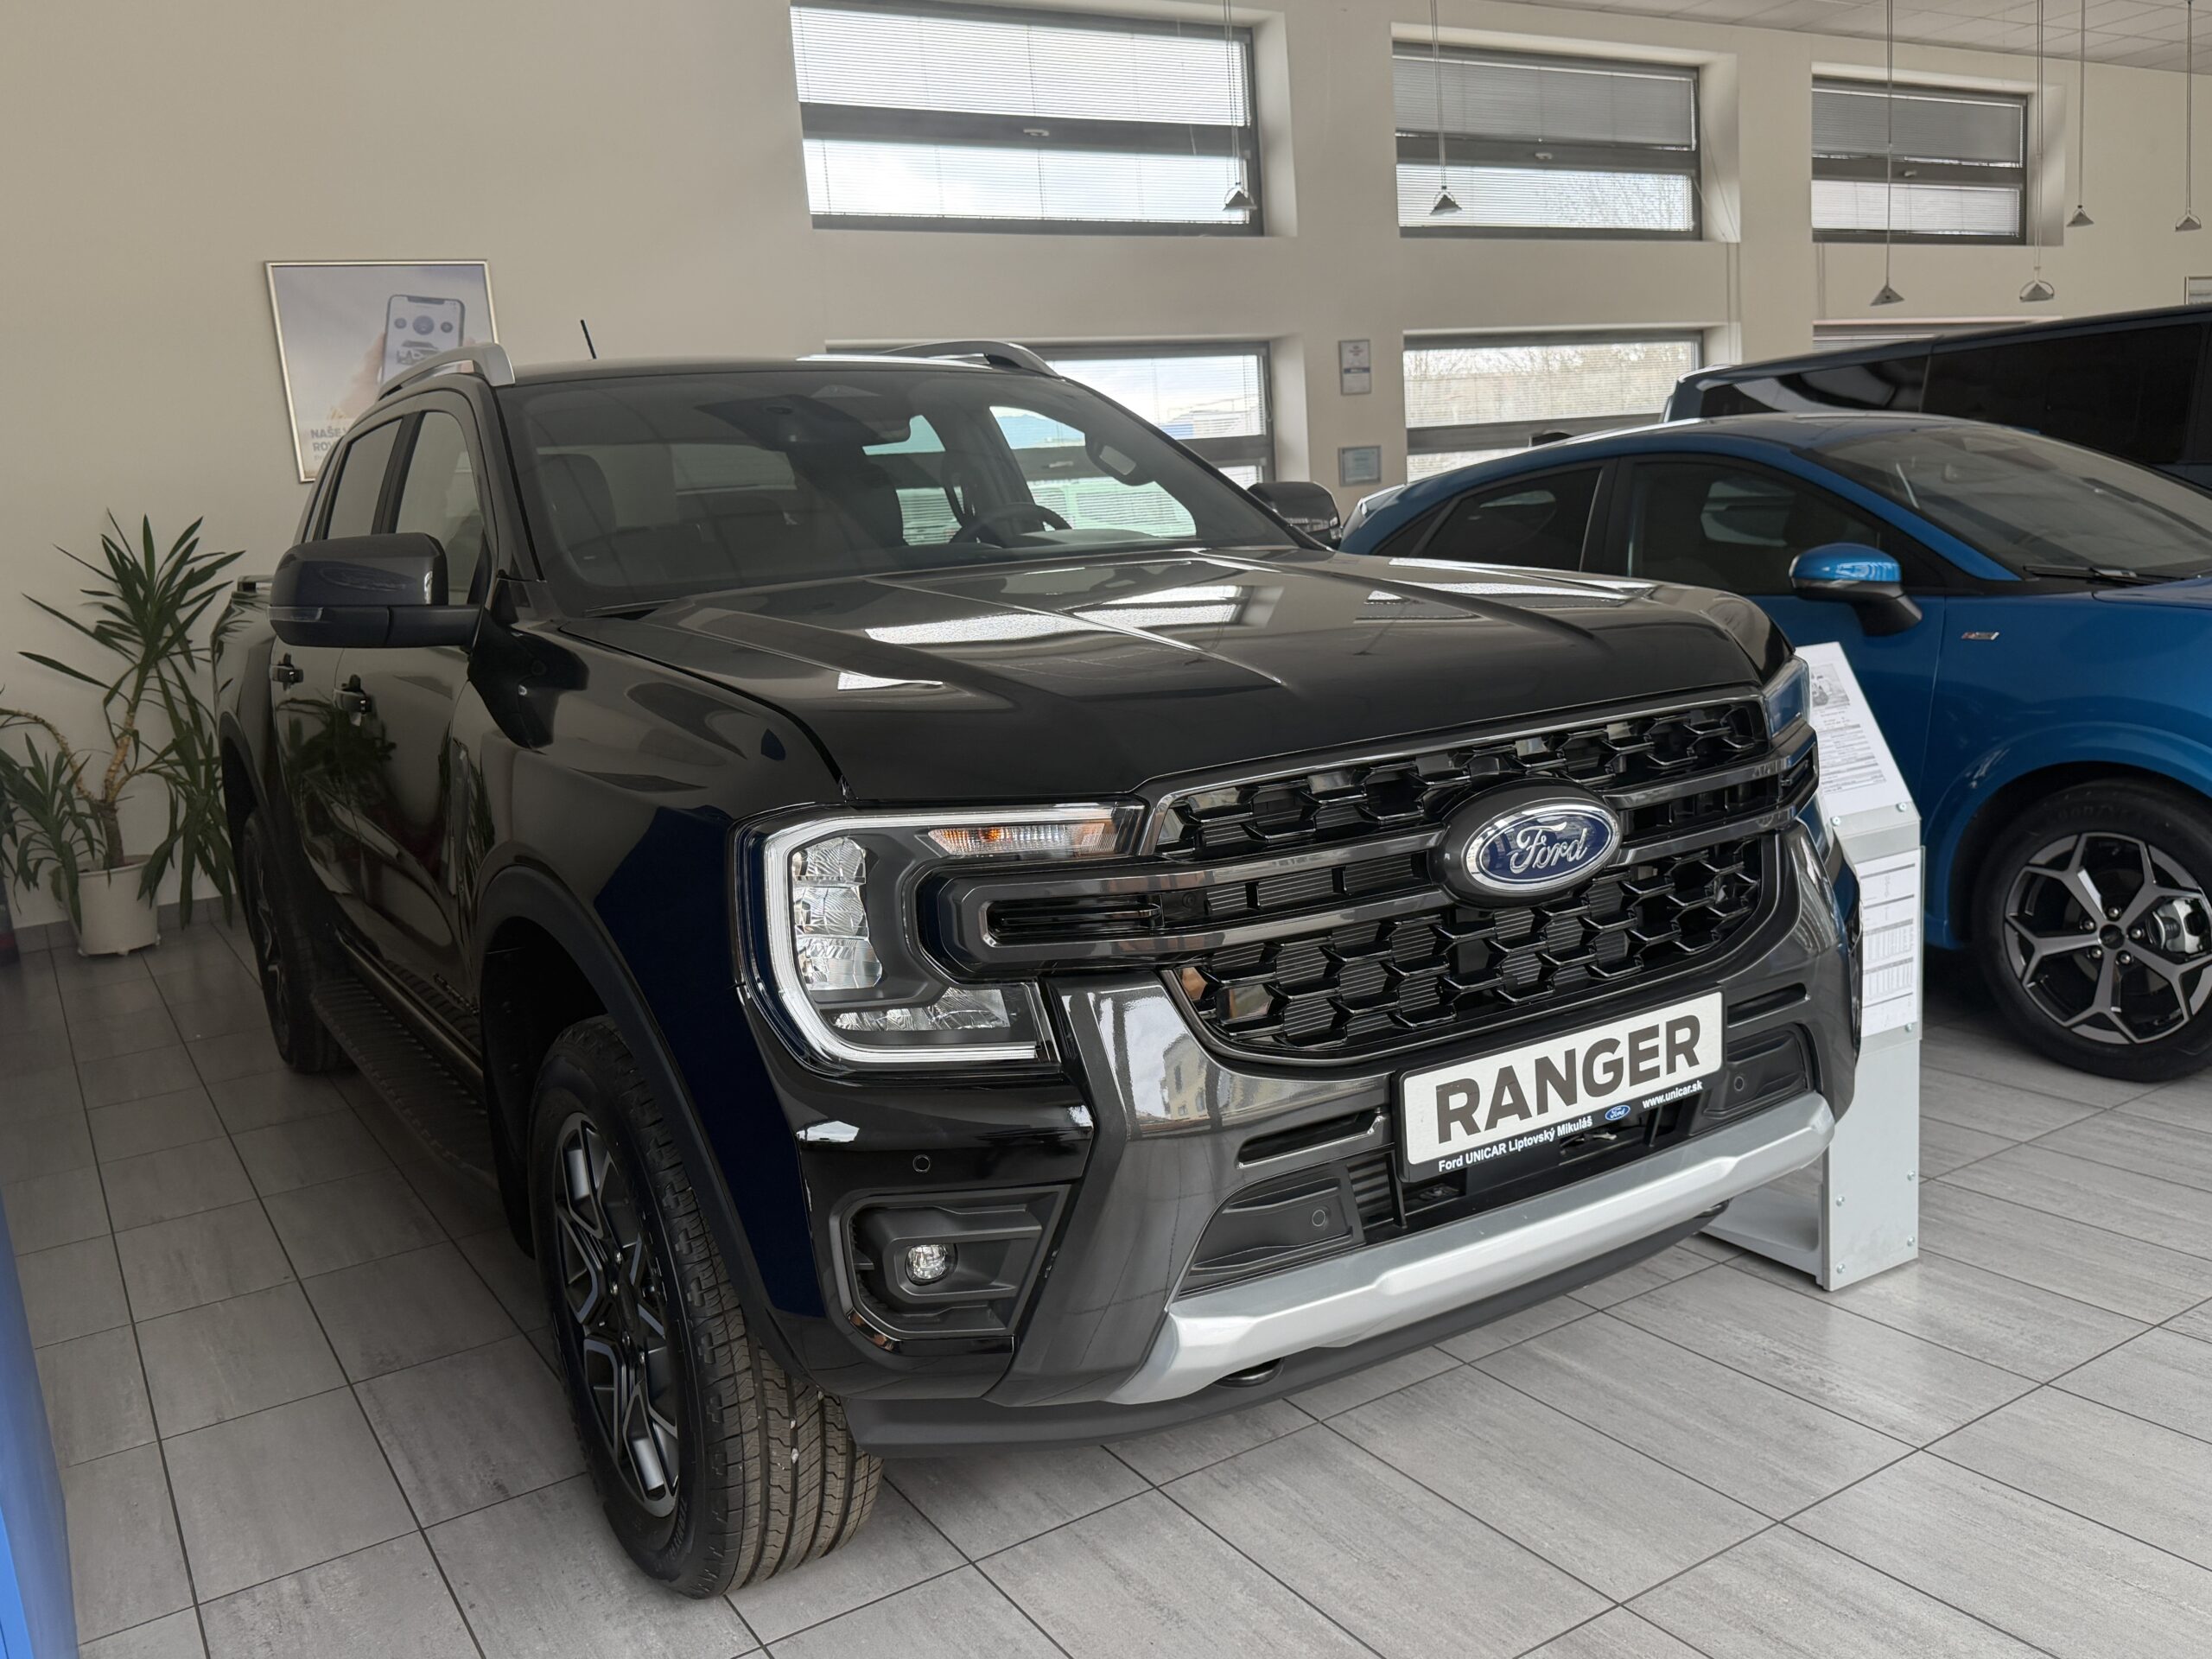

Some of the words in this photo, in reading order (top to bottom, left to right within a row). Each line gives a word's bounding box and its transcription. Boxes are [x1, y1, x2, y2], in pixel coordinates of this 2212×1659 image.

[1507, 821, 1588, 874] Ford
[1435, 1014, 1700, 1144] RANGER
[1642, 1080, 1703, 1109] www.unicar.sk
[1438, 1154, 1464, 1173] Ford
[1465, 1142, 1508, 1164] UNICAR
[1509, 1128, 1555, 1153] Liptovský
[1556, 1115, 1593, 1137] Mikuláš
